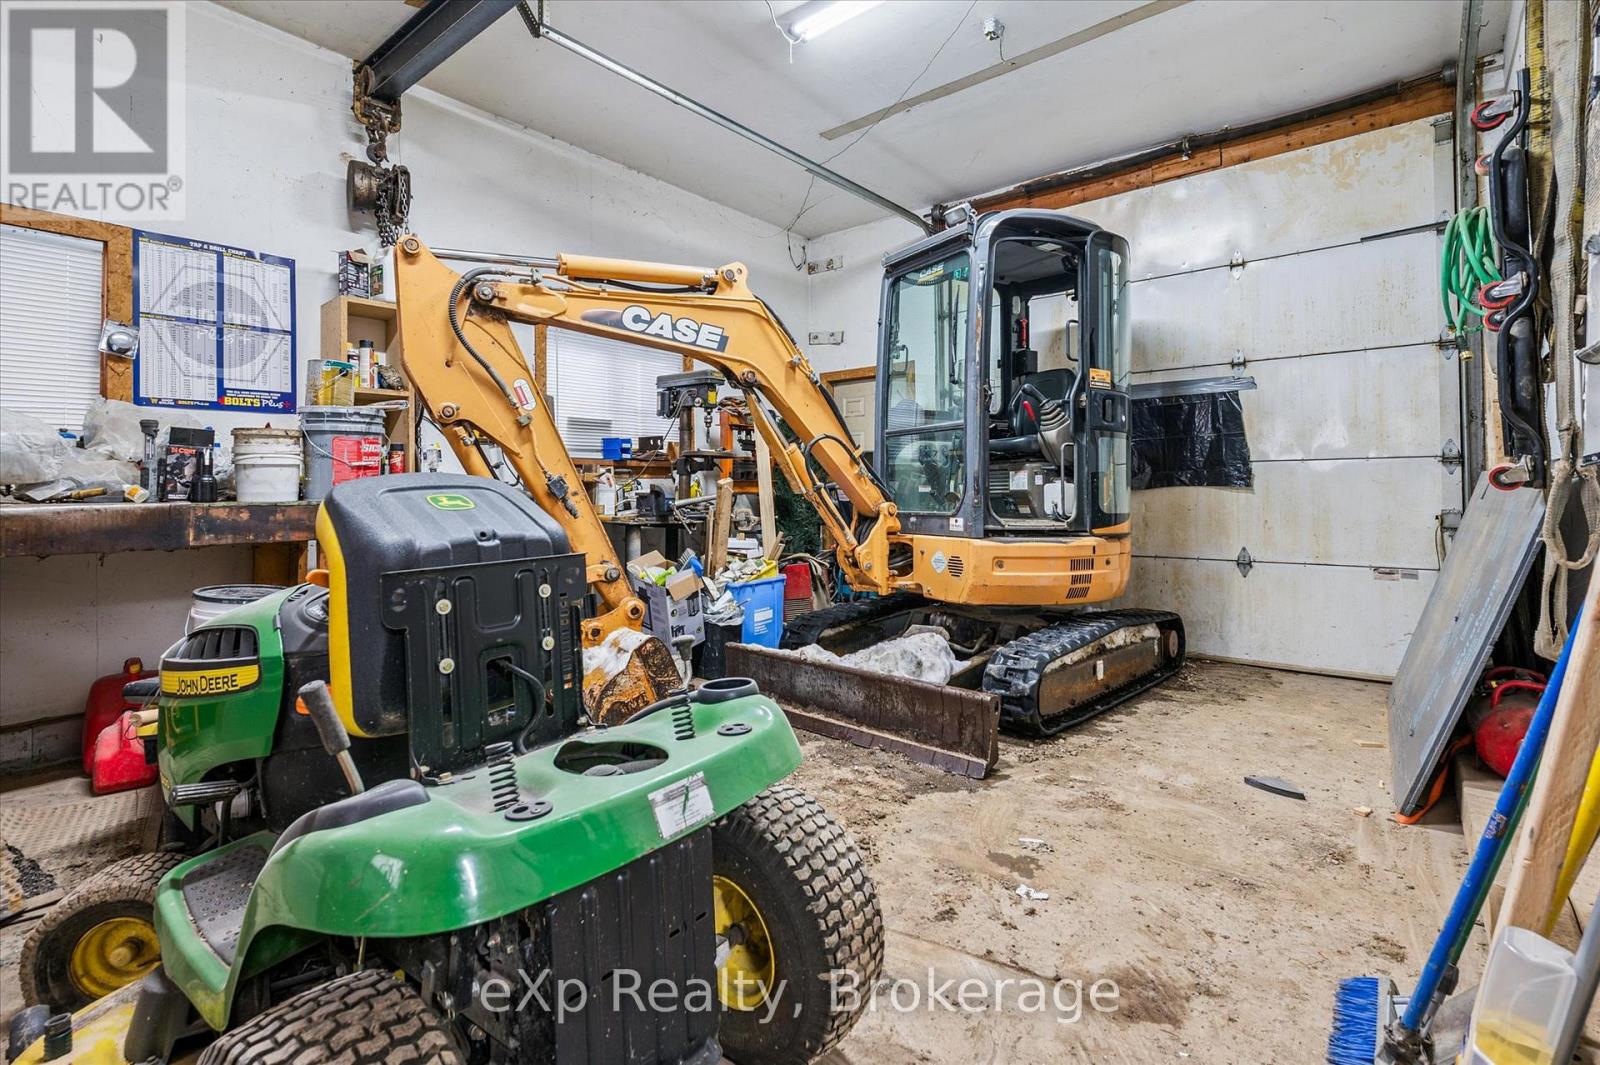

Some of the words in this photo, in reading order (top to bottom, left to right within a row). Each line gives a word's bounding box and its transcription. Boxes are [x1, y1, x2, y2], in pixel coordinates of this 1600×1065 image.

[189, 241, 203, 249] TAP
[227, 248, 247, 257] CHART
[621, 305, 725, 349] CASE
[223, 397, 261, 407] BOLTS
[176, 676, 200, 694] JOHN
[200, 673, 239, 692] DEERE
